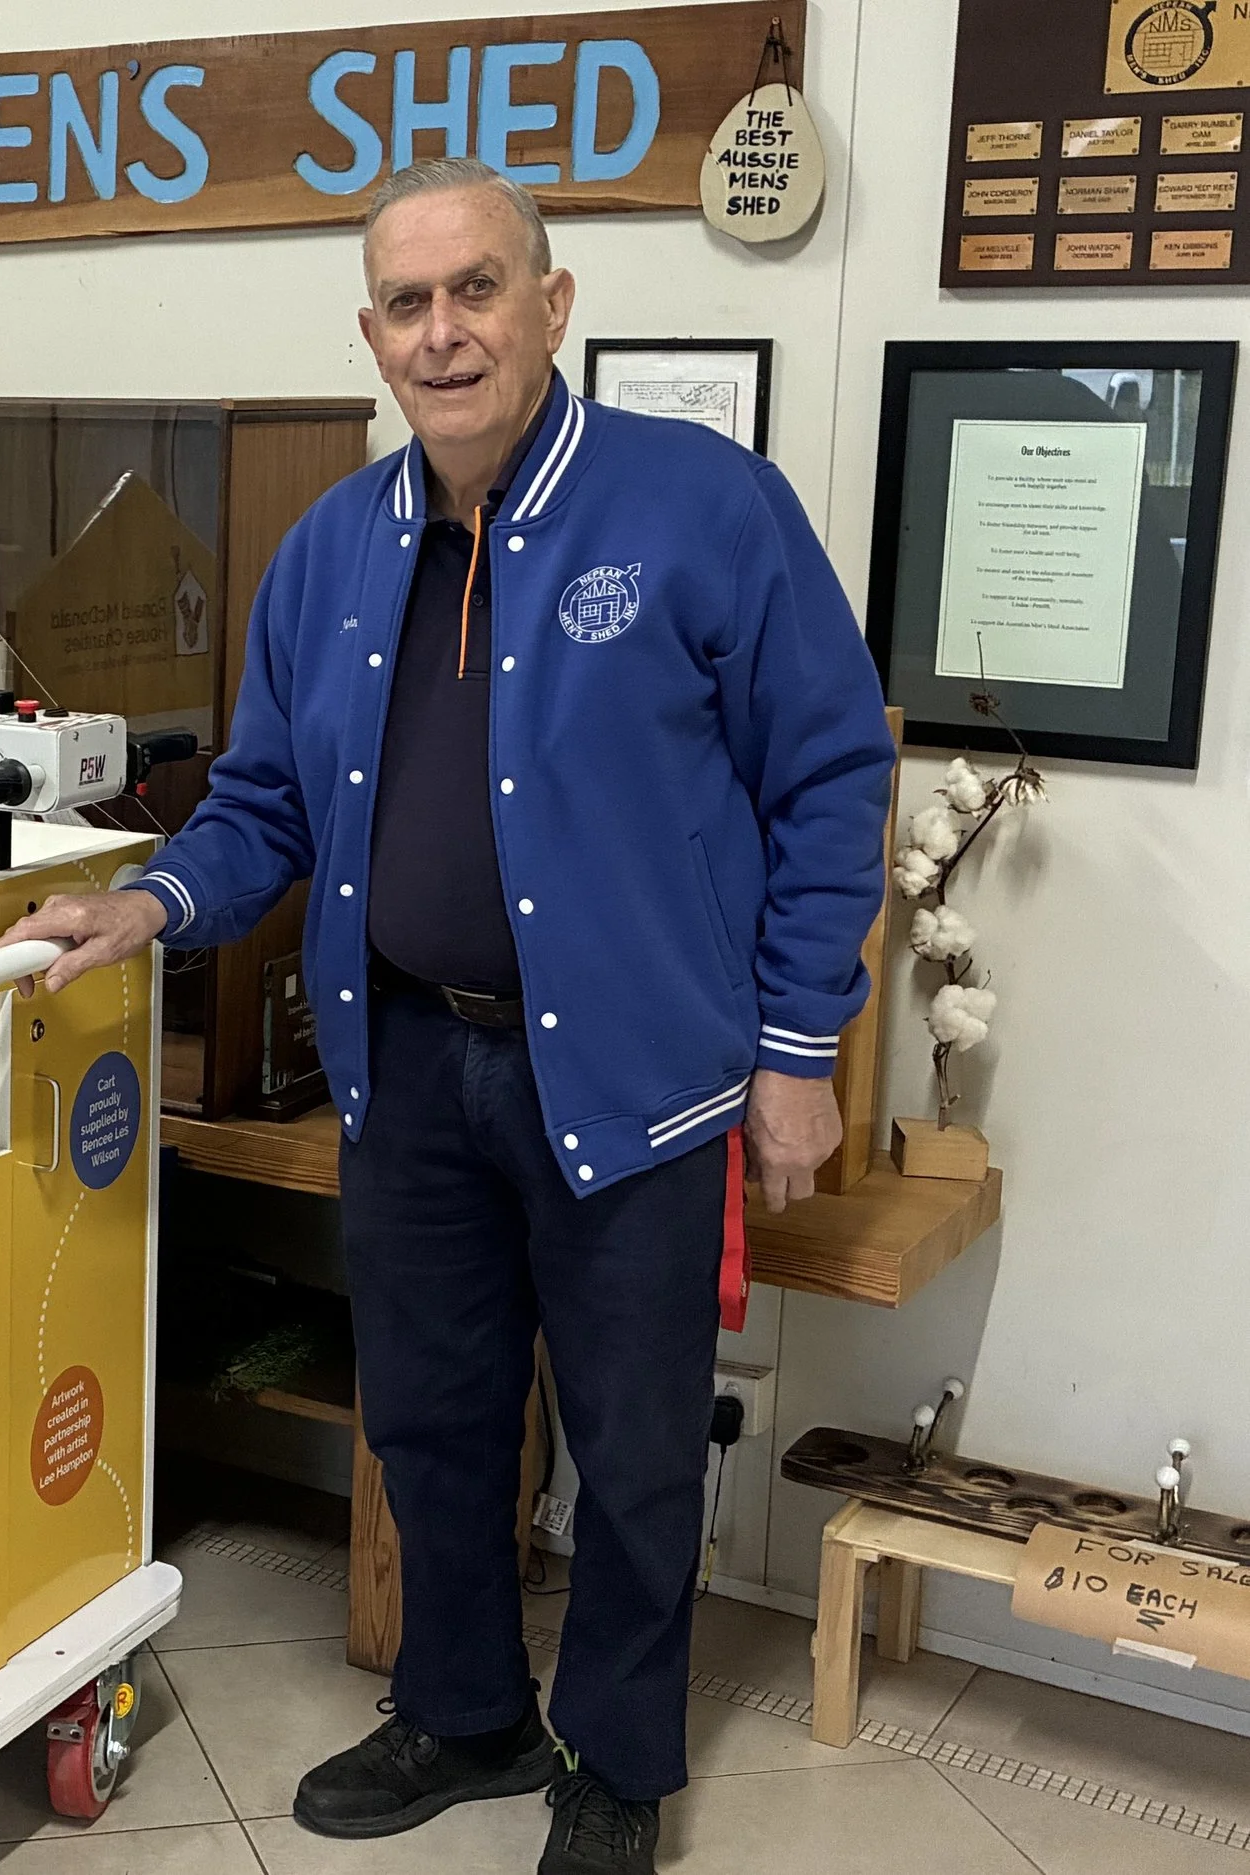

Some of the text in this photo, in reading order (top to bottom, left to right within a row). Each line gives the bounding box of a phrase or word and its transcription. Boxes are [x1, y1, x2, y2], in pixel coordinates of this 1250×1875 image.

[1150, 11, 1191, 32] NMS
[292, 39, 660, 194] SHED
[747, 110, 784, 129] THE
[735, 129, 793, 146] BEST
[978, 133, 1032, 143] JEFF THORNE
[1069, 129, 1134, 139] DANIEL TAYLOR
[718, 149, 799, 169] AUSSIE
[729, 169, 789, 190] MEN'S
[968, 190, 988, 198] JOHN
[1065, 187, 1130, 196] NORMAN SHAW
[726, 195, 780, 216] SHED
[1021, 445, 1071, 457] Our Objectives
[579, 569, 622, 586] NEPEAN
[583, 580, 616, 598] NMS
[590, 625, 620, 640] SHED
[622, 601, 637, 620] INC
[97, 1074, 115, 1092] Cart
[90, 1092, 121, 1116] proudly
[81, 1108, 129, 1136] supplied by
[82, 1126, 129, 1154] Bencee Les
[91, 1147, 120, 1168] Wilson
[51, 1381, 85, 1409] Artwork
[47, 1398, 89, 1429] created in
[44, 1414, 91, 1453] partnership
[47, 1432, 88, 1465] with artist
[39, 1448, 93, 1489] Lee Hampton
[1074, 1537, 1250, 1586] FOR SALE
[1126, 1582, 1198, 1619] EACH
